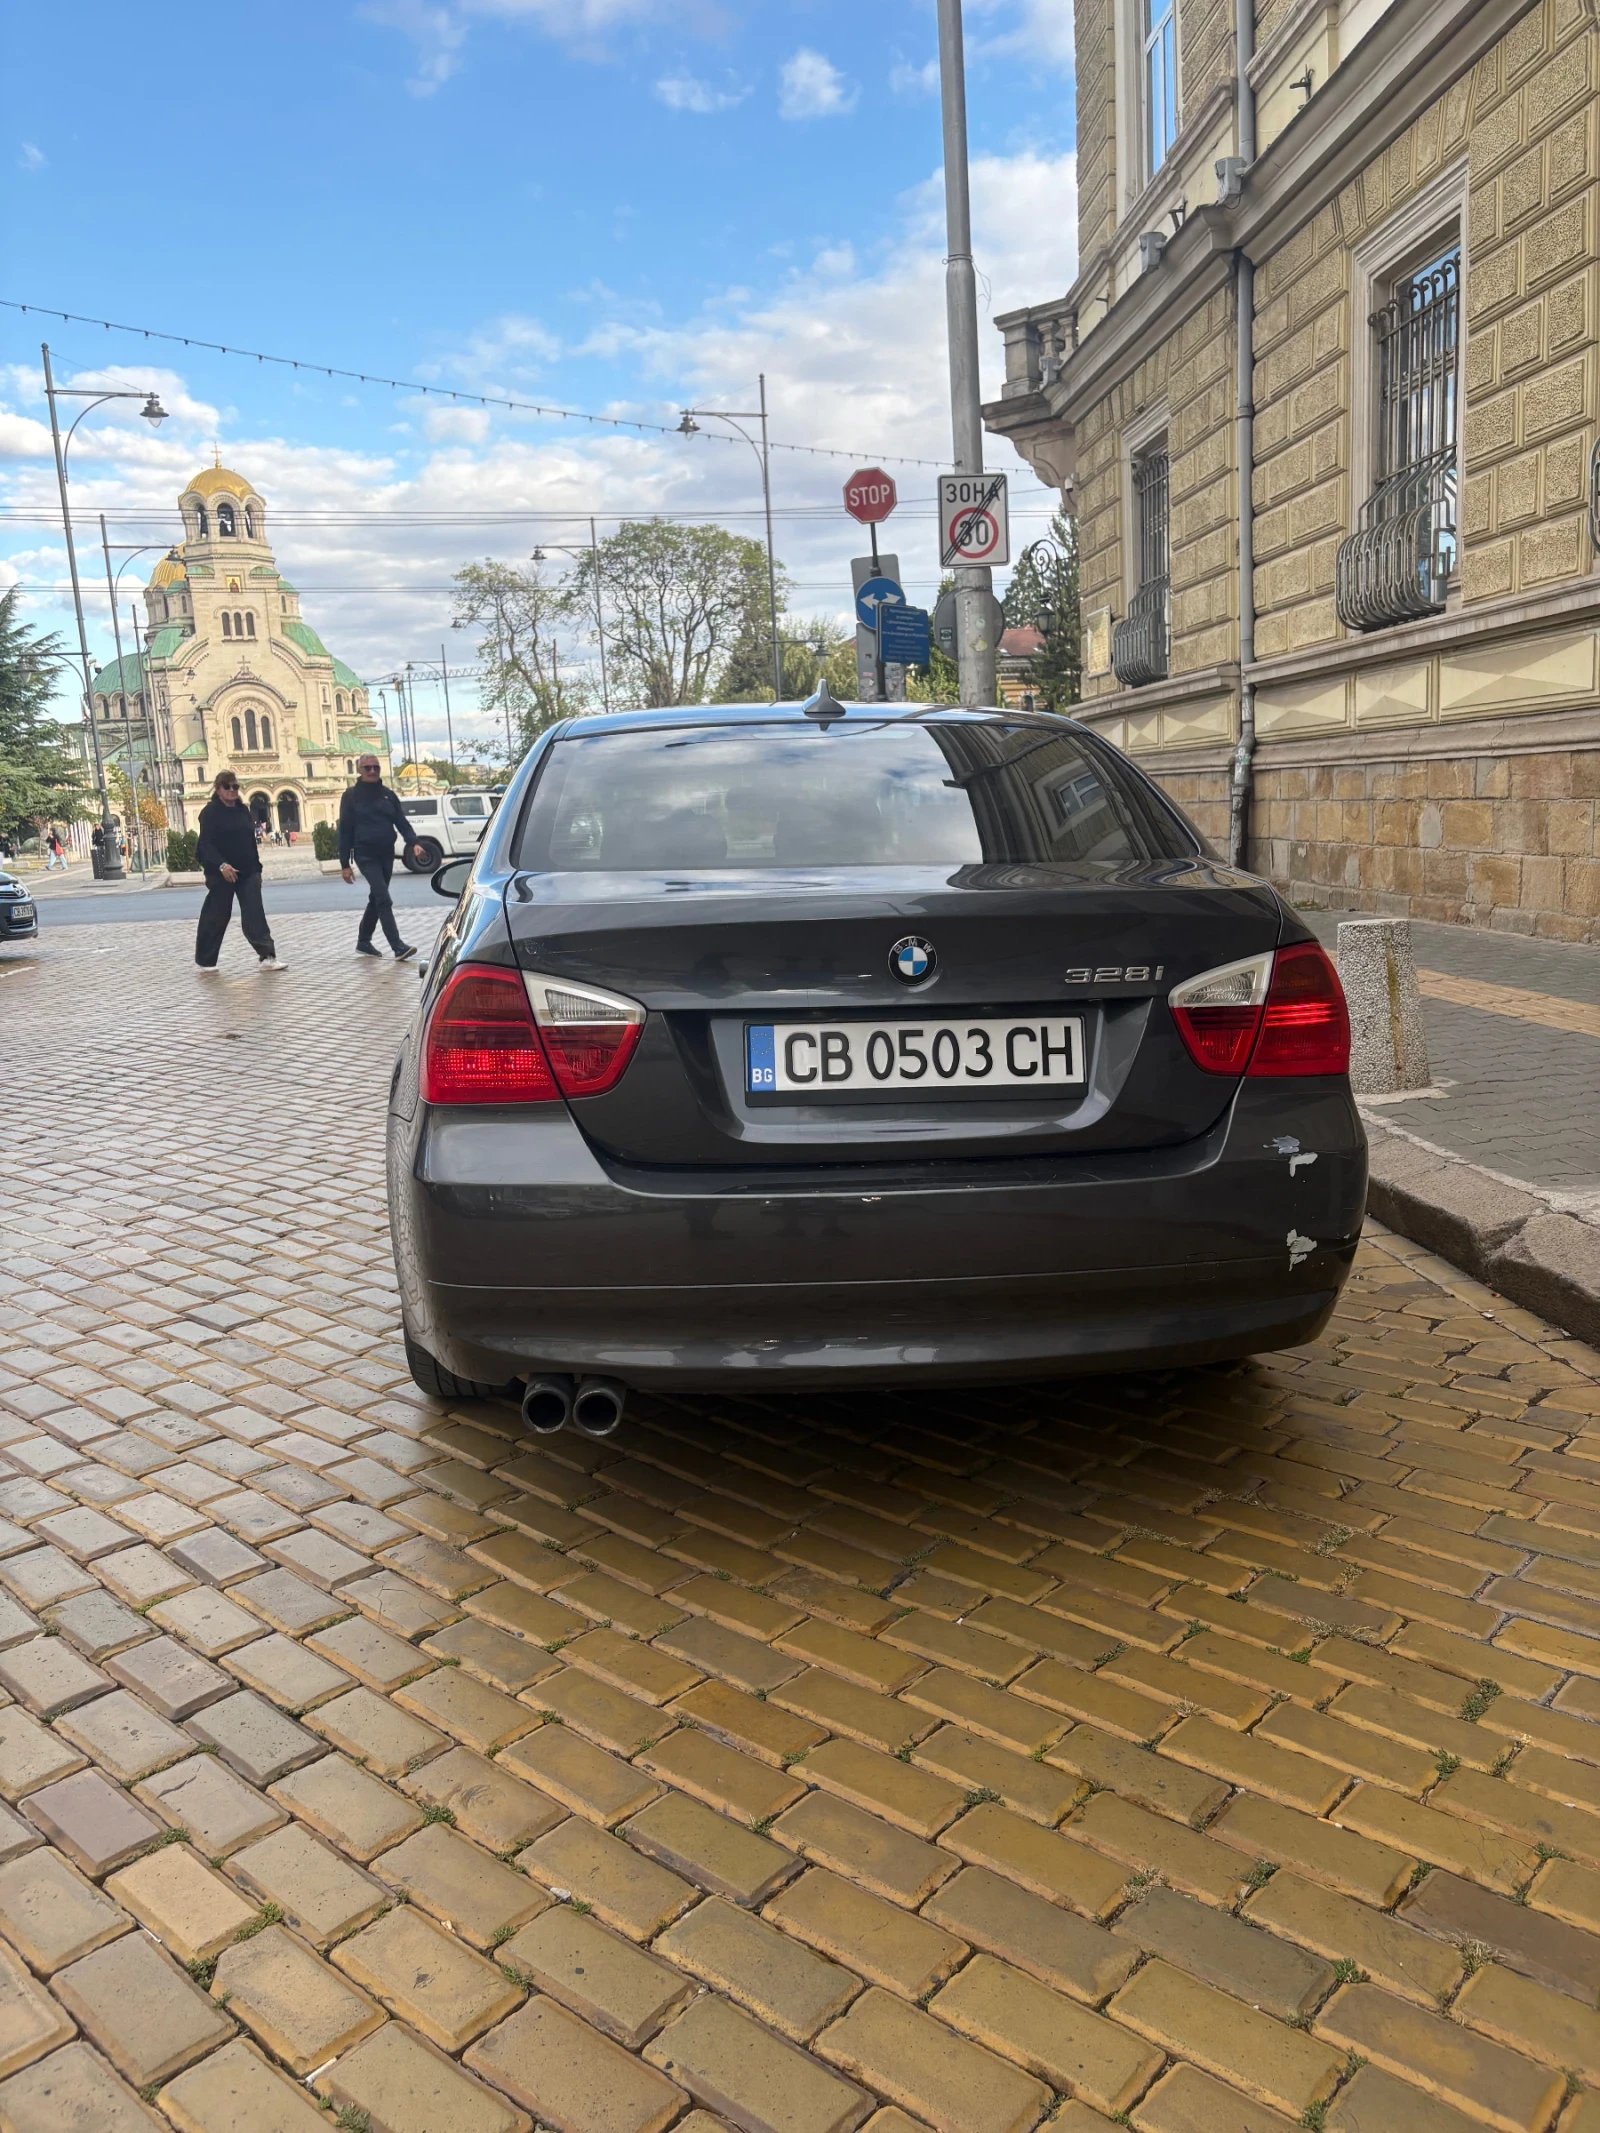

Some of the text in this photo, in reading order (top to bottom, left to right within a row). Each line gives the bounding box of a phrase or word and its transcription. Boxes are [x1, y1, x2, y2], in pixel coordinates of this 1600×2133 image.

[849, 484, 891, 507] STOP
[959, 519, 989, 546] 30
[893, 937, 933, 955] BMW
[1064, 965, 1165, 984] 328i
[785, 1026, 1073, 1083] CB 0503 CH
[752, 1068, 773, 1083] BG
